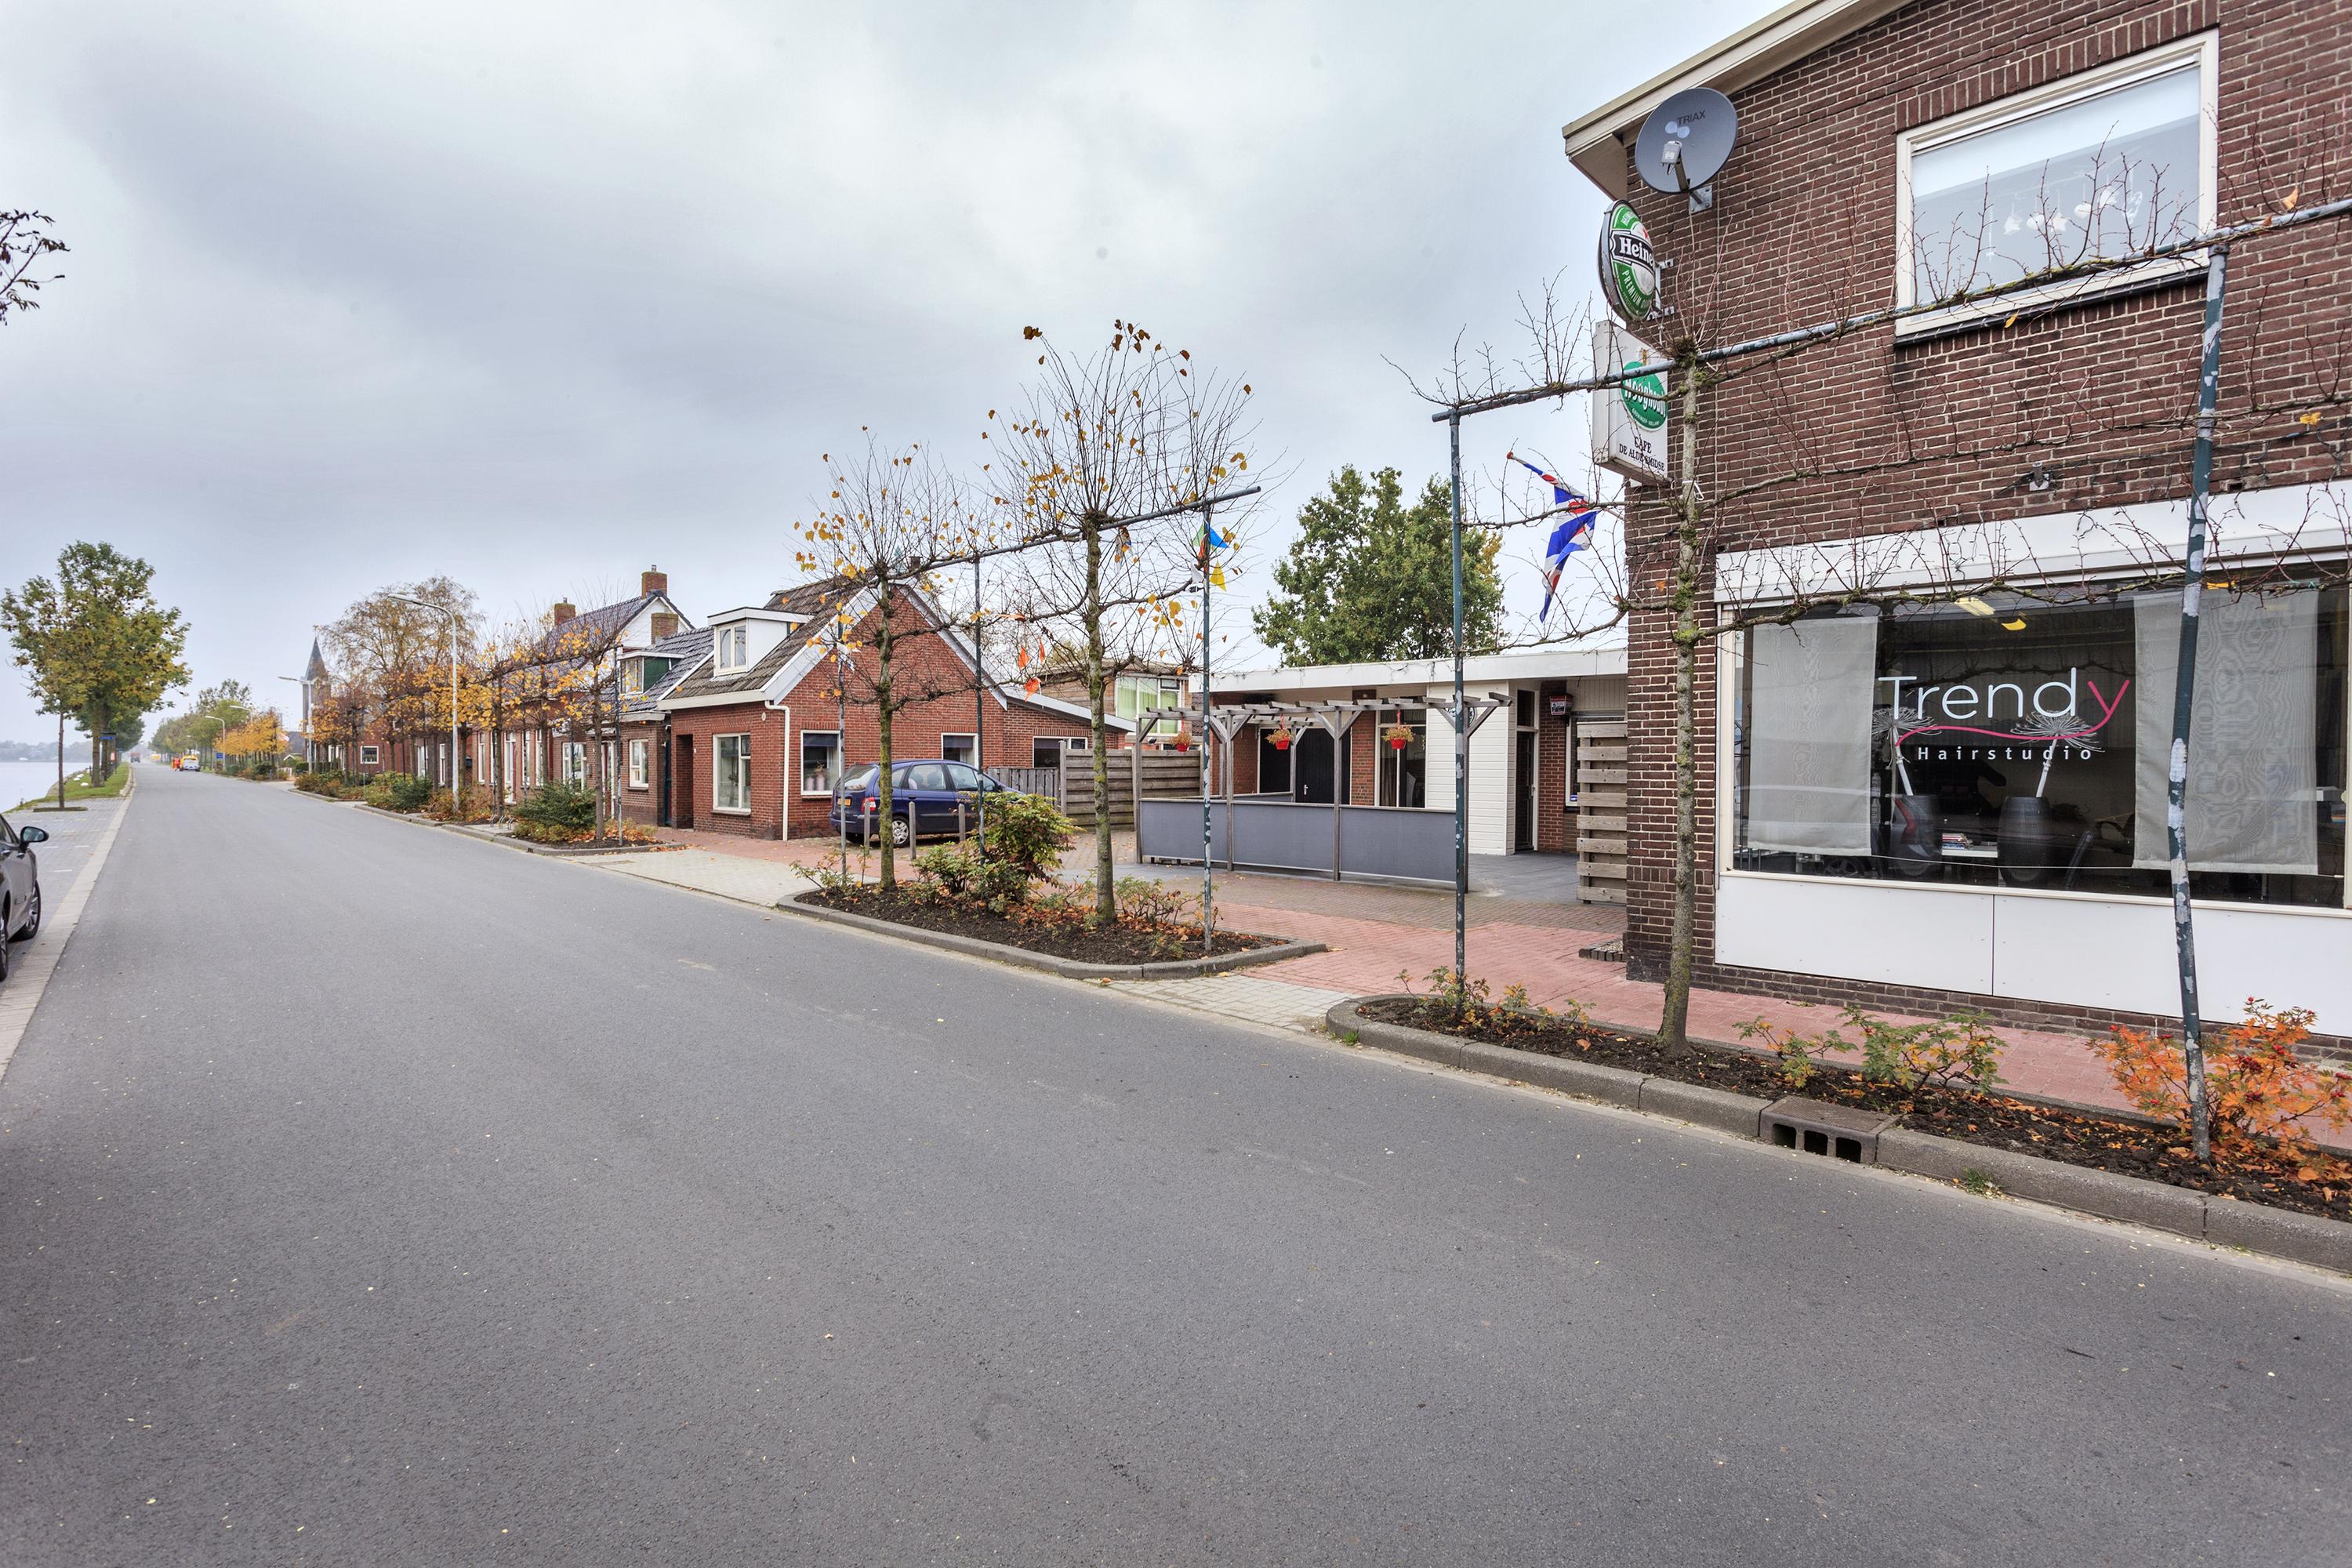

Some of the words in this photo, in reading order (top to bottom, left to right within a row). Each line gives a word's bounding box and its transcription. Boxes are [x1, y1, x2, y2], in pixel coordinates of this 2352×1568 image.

[1677, 111, 1706, 125] TRIAX
[1619, 237, 1655, 269] Heine
[1622, 270, 1642, 306] PREMIUM
[1619, 444, 1628, 455] DE
[1878, 667, 2130, 741] Trendy
[1918, 746, 2092, 760] Hairstudio
